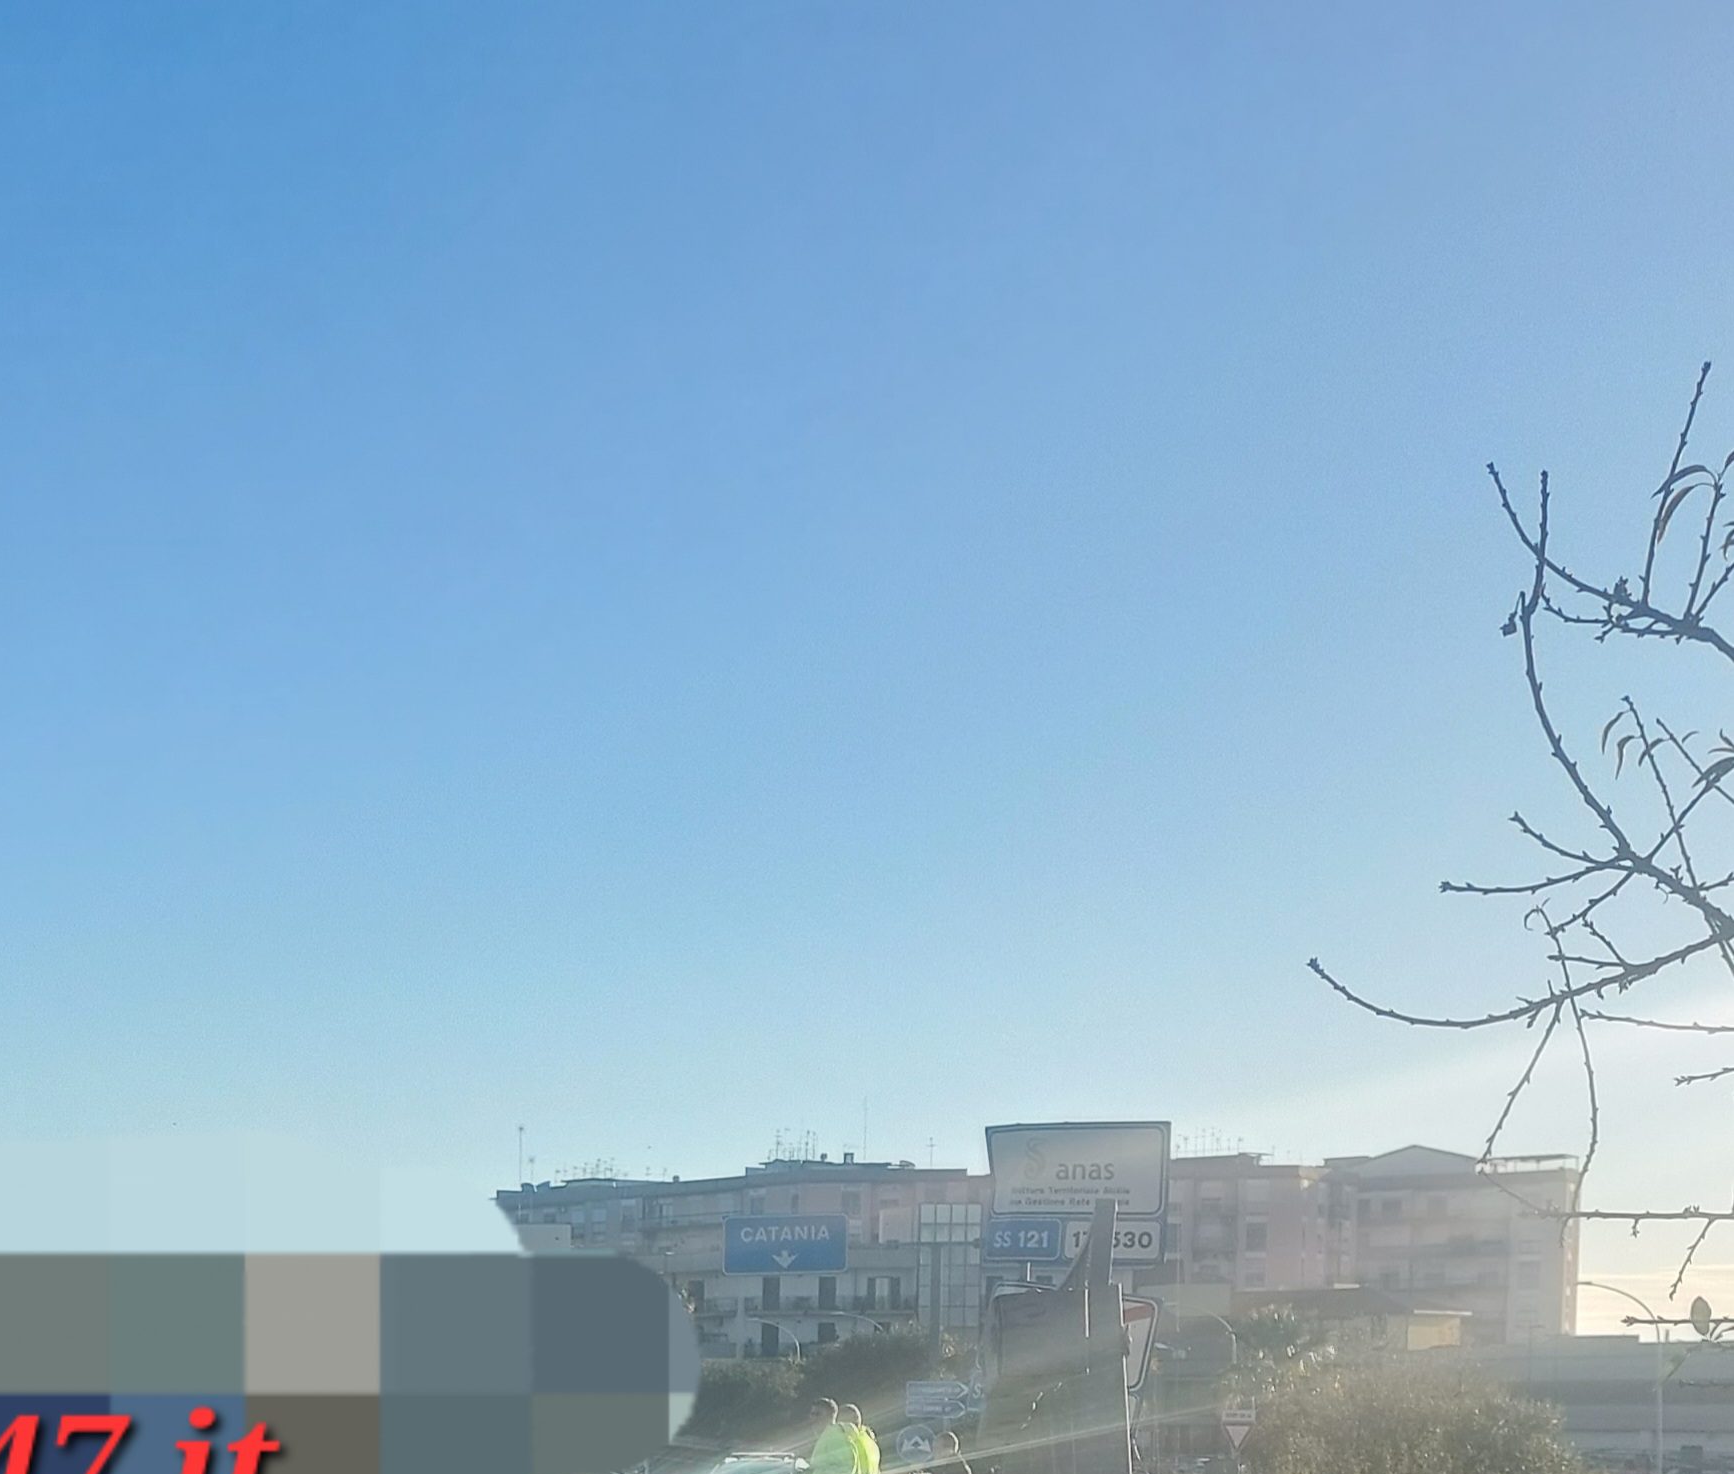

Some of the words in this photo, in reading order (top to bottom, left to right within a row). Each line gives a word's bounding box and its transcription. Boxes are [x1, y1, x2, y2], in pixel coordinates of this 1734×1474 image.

[1055, 1162, 1115, 1181] anas
[740, 1224, 830, 1243] CATANIA
[993, 1231, 1012, 1248] SS
[1017, 1230, 1049, 1248] 121
